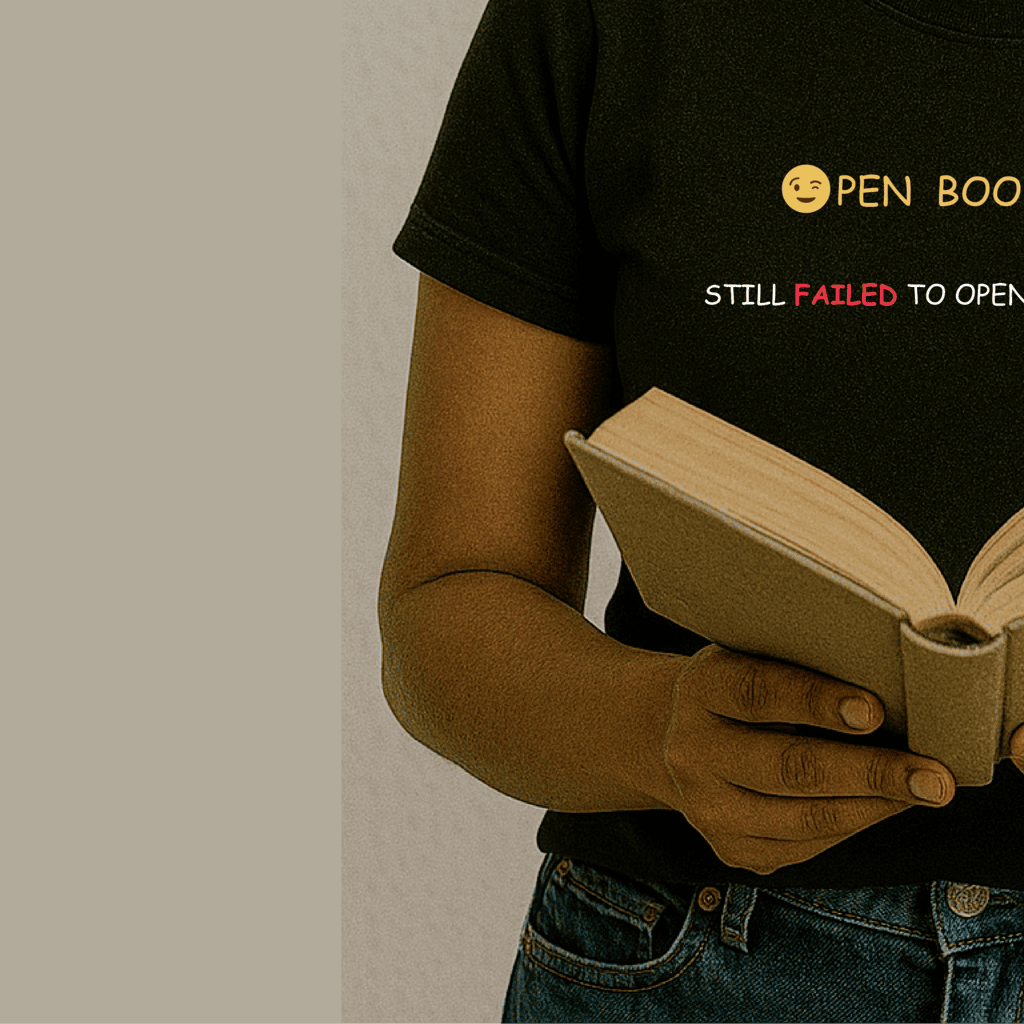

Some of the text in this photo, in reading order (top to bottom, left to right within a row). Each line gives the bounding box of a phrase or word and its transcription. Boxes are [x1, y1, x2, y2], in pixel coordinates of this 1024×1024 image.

[704, 283, 786, 307] STILL
[795, 282, 898, 307] FAILED
[906, 283, 946, 307] TO
